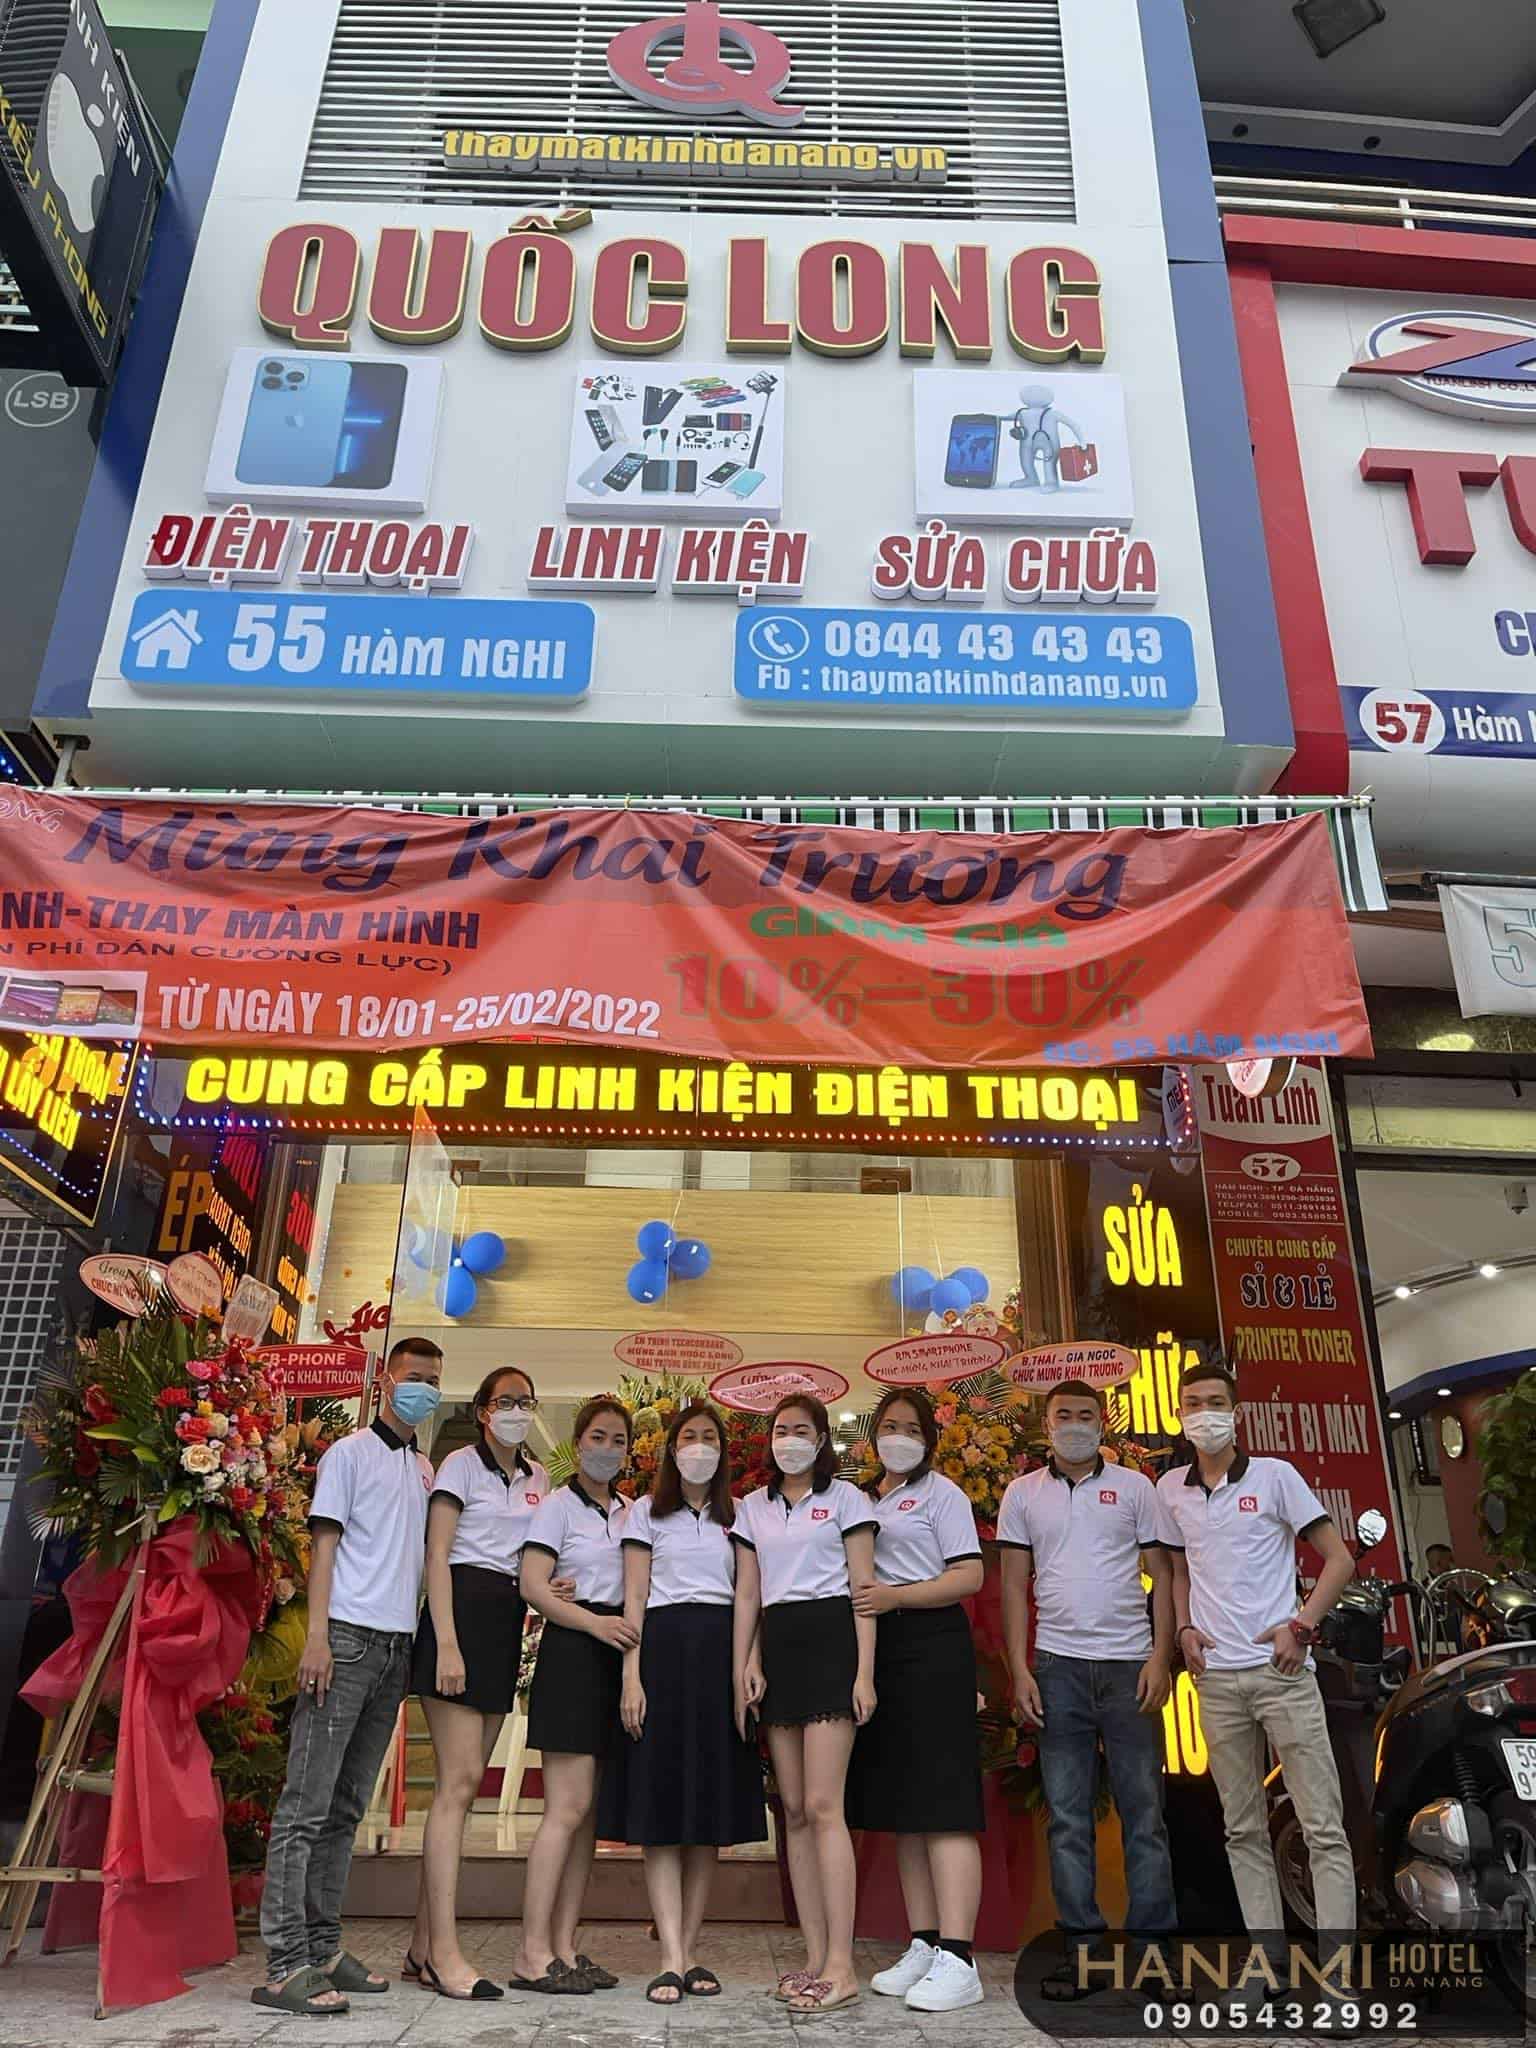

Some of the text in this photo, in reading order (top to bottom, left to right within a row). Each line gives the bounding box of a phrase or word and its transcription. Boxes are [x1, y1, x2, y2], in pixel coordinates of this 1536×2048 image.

[442, 129, 948, 180] thaymatkinhdanang.vn
[42, 191, 108, 338] PHONG
[257, 208, 1106, 361] QUỐC LONG
[13, 391, 70, 409] LSB
[1358, 447, 1536, 566] T
[145, 505, 474, 590] ĐIỆN THOẠI
[527, 518, 809, 598] LINH KIỆN
[872, 519, 1160, 600] SỬA CHỮA
[227, 603, 566, 681] 55 HÀM NGHI
[825, 620, 1162, 664] 0844 43 43 43
[758, 664, 791, 690] Fb
[821, 665, 1168, 699] thaymatkinhdanang.vn
[1375, 702, 1433, 745] 57
[1451, 704, 1522, 743] Hàm
[63, 806, 1129, 921] Mừng Khai Trương
[223, 904, 343, 941] MÀN
[358, 905, 480, 950] HÌNH
[27, 938, 82, 955] PHÍ
[96, 939, 176, 956] DÁN
[357, 952, 453, 975] LỰC)
[158, 976, 661, 1038] TỪ NGÀY 18/01-25/02/2022
[1112, 1037, 1155, 1059] 55
[1167, 1030, 1244, 1057] HÀM
[1254, 1031, 1340, 1054] NGHI
[185, 1057, 349, 1106] CUNG
[368, 1047, 487, 1108] CẤP
[504, 1065, 637, 1111] LINH
[657, 1060, 793, 1122] KIỆN
[812, 1063, 949, 1126] ĐIỆN
[968, 1075, 1140, 1131] THOẠI
[1252, 1157, 1289, 1177] 57
[158, 1153, 214, 1252] ÉP
[1103, 1183, 1183, 1287] SỬA
[1225, 1234, 1337, 1260] CHUYÊN CUNG CẤP
[1240, 1261, 1337, 1311] SỈ & LẺ
[1066, 1352, 1084, 1363] GIA
[1234, 1326, 1357, 1367] PRINTER TONER
[297, 1370, 322, 1384] KHAI
[1065, 1364, 1086, 1380] KHAI
[1236, 1385, 1370, 1465] THIẾT BỊ MÁY
